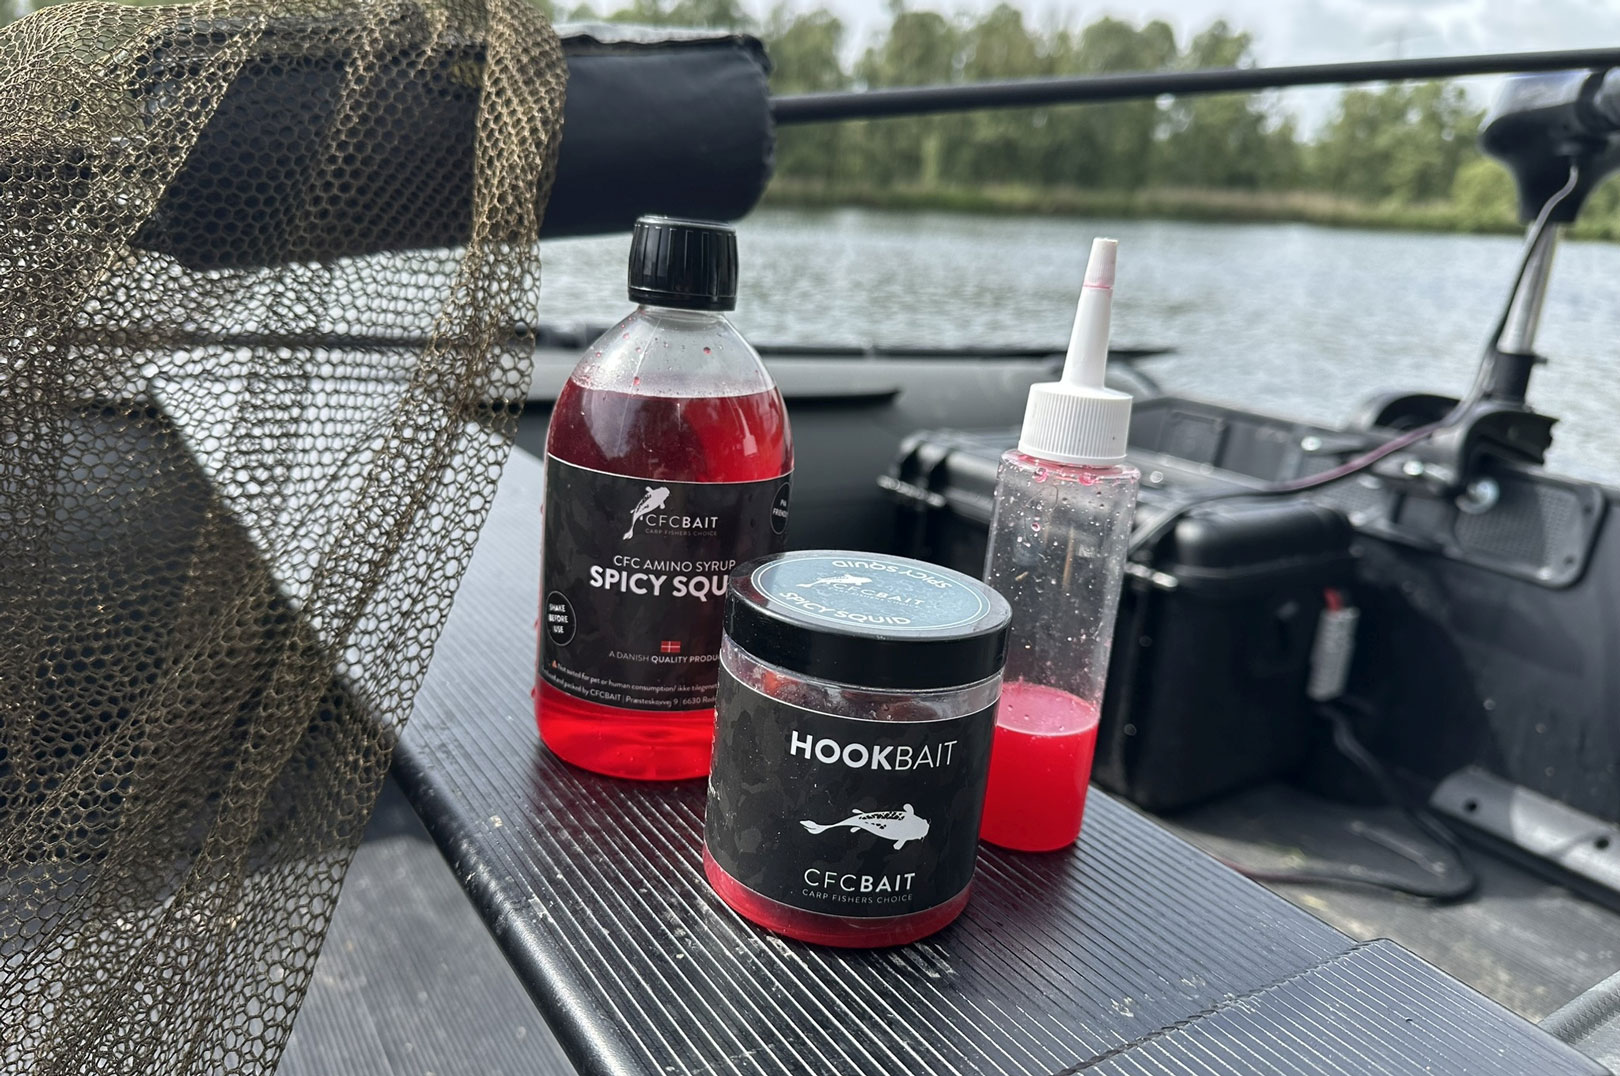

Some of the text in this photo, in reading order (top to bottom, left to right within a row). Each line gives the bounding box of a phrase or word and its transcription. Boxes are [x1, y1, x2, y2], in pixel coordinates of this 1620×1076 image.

[645, 513, 718, 529] CFCBAIT
[664, 528, 691, 536] FISHERS
[613, 555, 736, 573] CFC AMINO SYRUP
[589, 564, 729, 602] SPICY SQU
[832, 559, 952, 589] SPICY SQUID
[833, 583, 925, 605] CFCBAIT
[549, 603, 566, 613] SHAKE
[779, 591, 836, 614] SPICY
[834, 610, 911, 625] SQUID
[548, 613, 569, 624] BEFORE
[553, 625, 564, 634] USE
[609, 650, 615, 658] A
[616, 651, 649, 662] DANISH
[651, 655, 688, 664] QUALITY
[581, 672, 590, 681] for
[608, 680, 631, 690] human
[582, 686, 590, 696] by
[590, 688, 621, 701] CFCBAIT
[682, 696, 701, 705] 6630
[790, 730, 958, 771] HOOKBAIT
[804, 868, 916, 892] CFCBAIT
[802, 888, 913, 904] CARP FISHERS CHOICE
